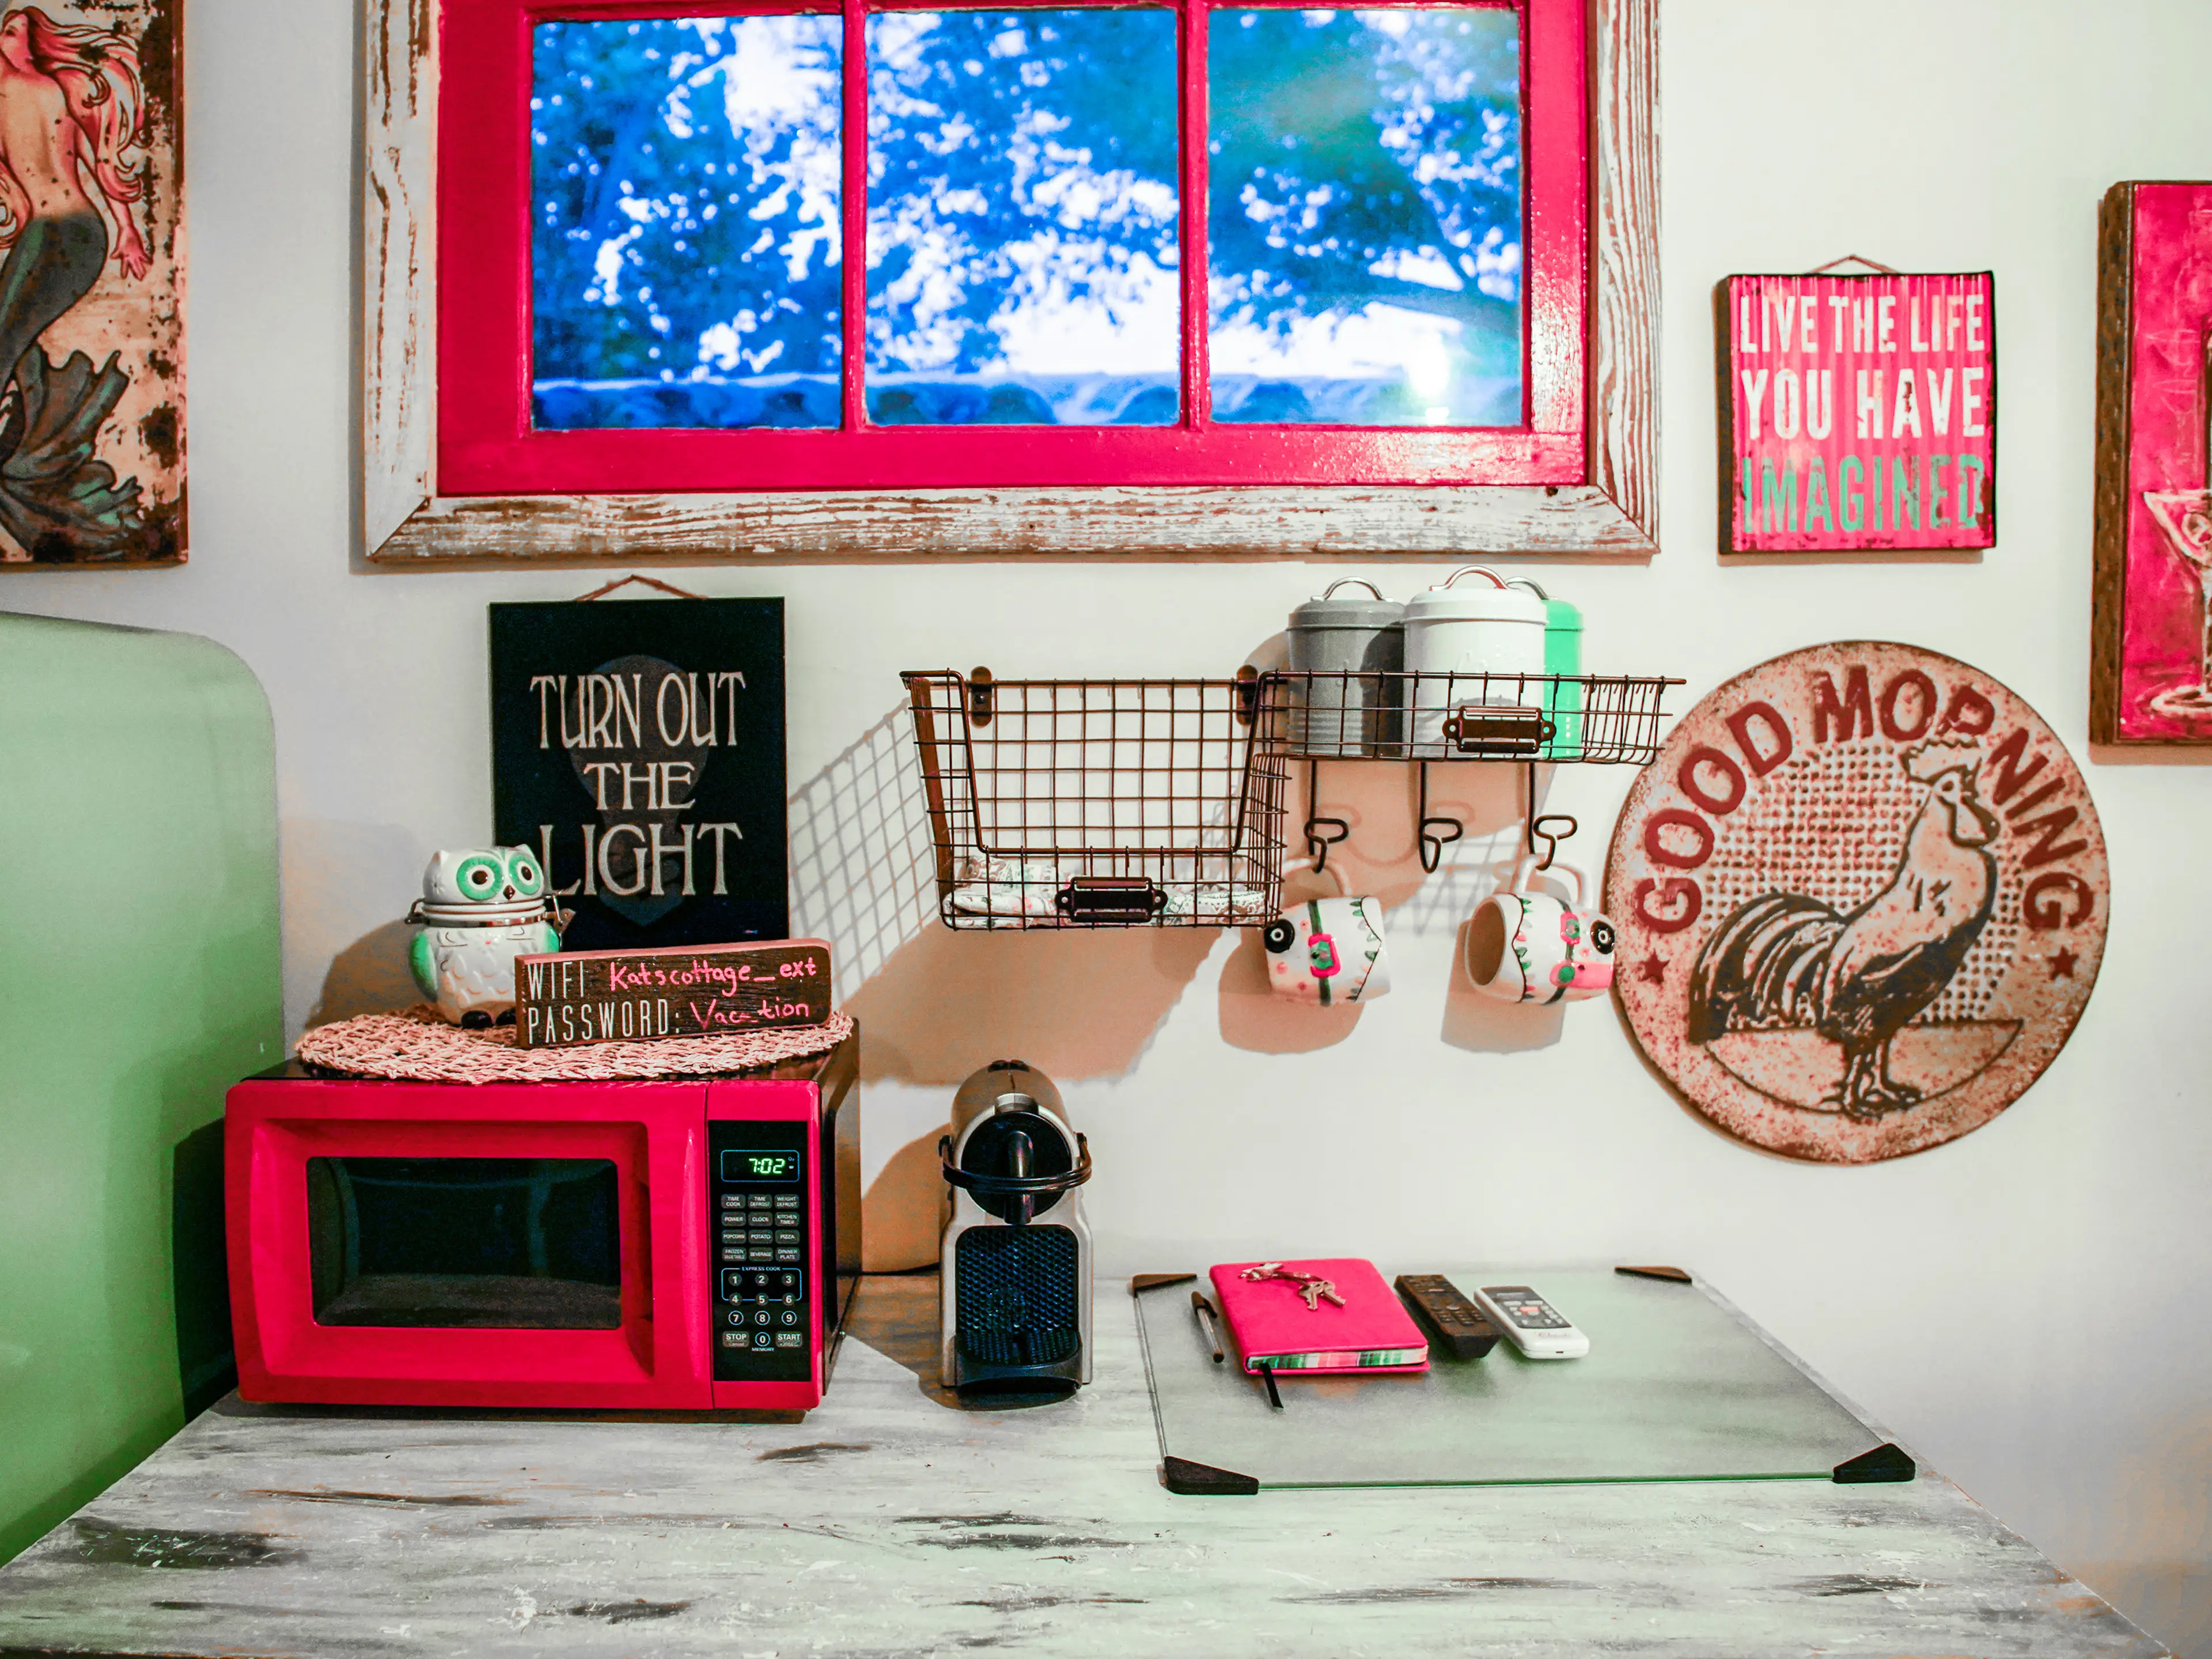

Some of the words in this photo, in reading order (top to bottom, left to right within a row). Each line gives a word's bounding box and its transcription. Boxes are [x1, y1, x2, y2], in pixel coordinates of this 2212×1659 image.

[1740, 295, 1817, 353] LIVE
[1828, 295, 1896, 353] THE
[1910, 294, 1984, 352] LIFE
[1740, 368, 1832, 440] YOU
[1857, 367, 1984, 439] HAVE
[1742, 454, 1985, 532] IMAGINED
[530, 674, 641, 748] TURN
[657, 672, 747, 747] OUT
[584, 762, 696, 810] THE
[1634, 700, 1793, 934] GOOD
[540, 823, 744, 896] LIGHT
[527, 960, 585, 1000] WIFI
[528, 998, 680, 1044] PASSWORD:
[748, 1158, 786, 1174] 7:02
[759, 1335, 766, 1343] 0
